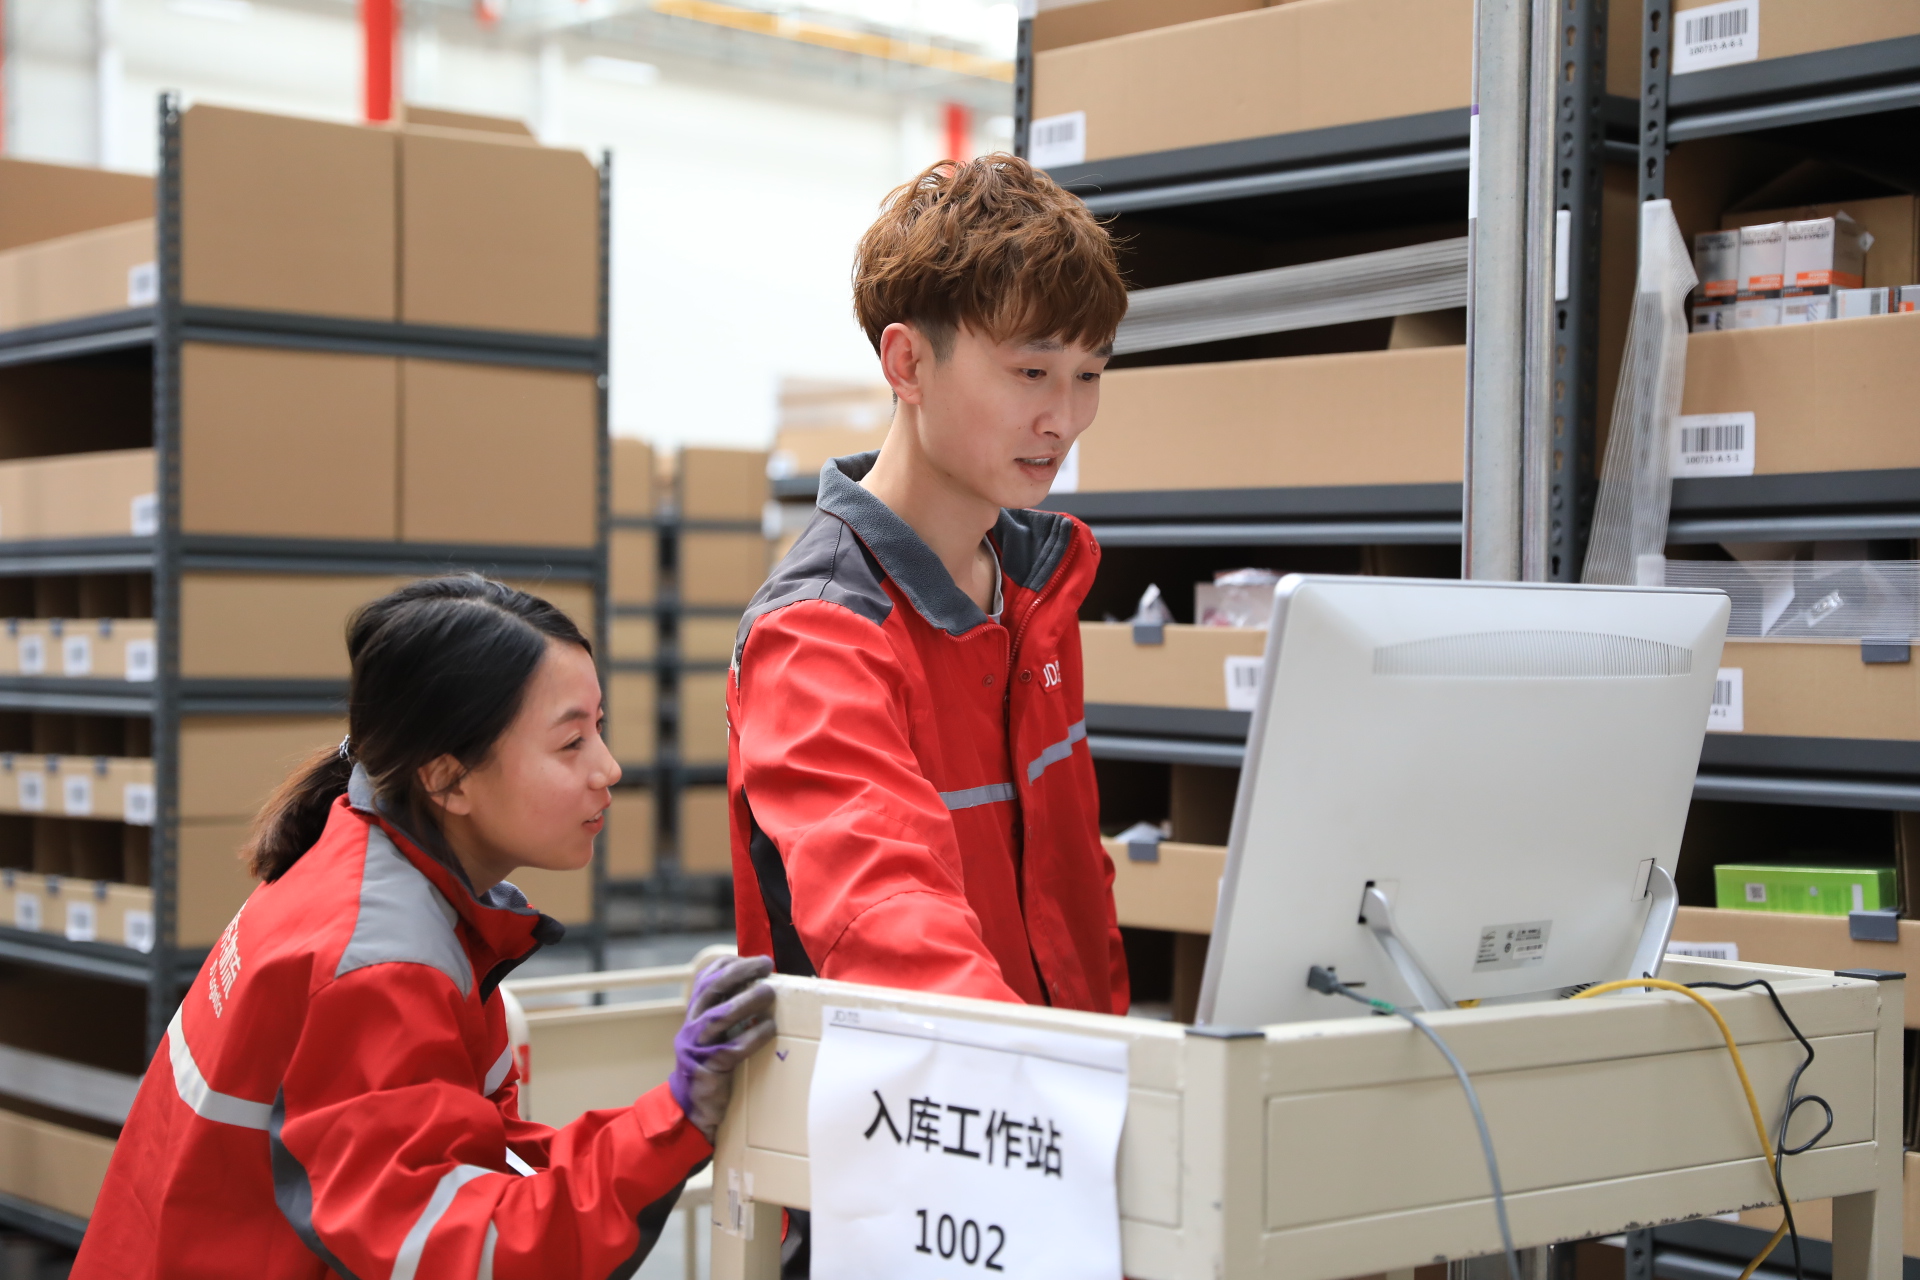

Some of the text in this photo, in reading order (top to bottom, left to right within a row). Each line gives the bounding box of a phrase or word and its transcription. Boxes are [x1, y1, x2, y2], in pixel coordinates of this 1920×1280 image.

[864, 1089, 1062, 1177] 入库工作站
[915, 1209, 1005, 1272] 1002
